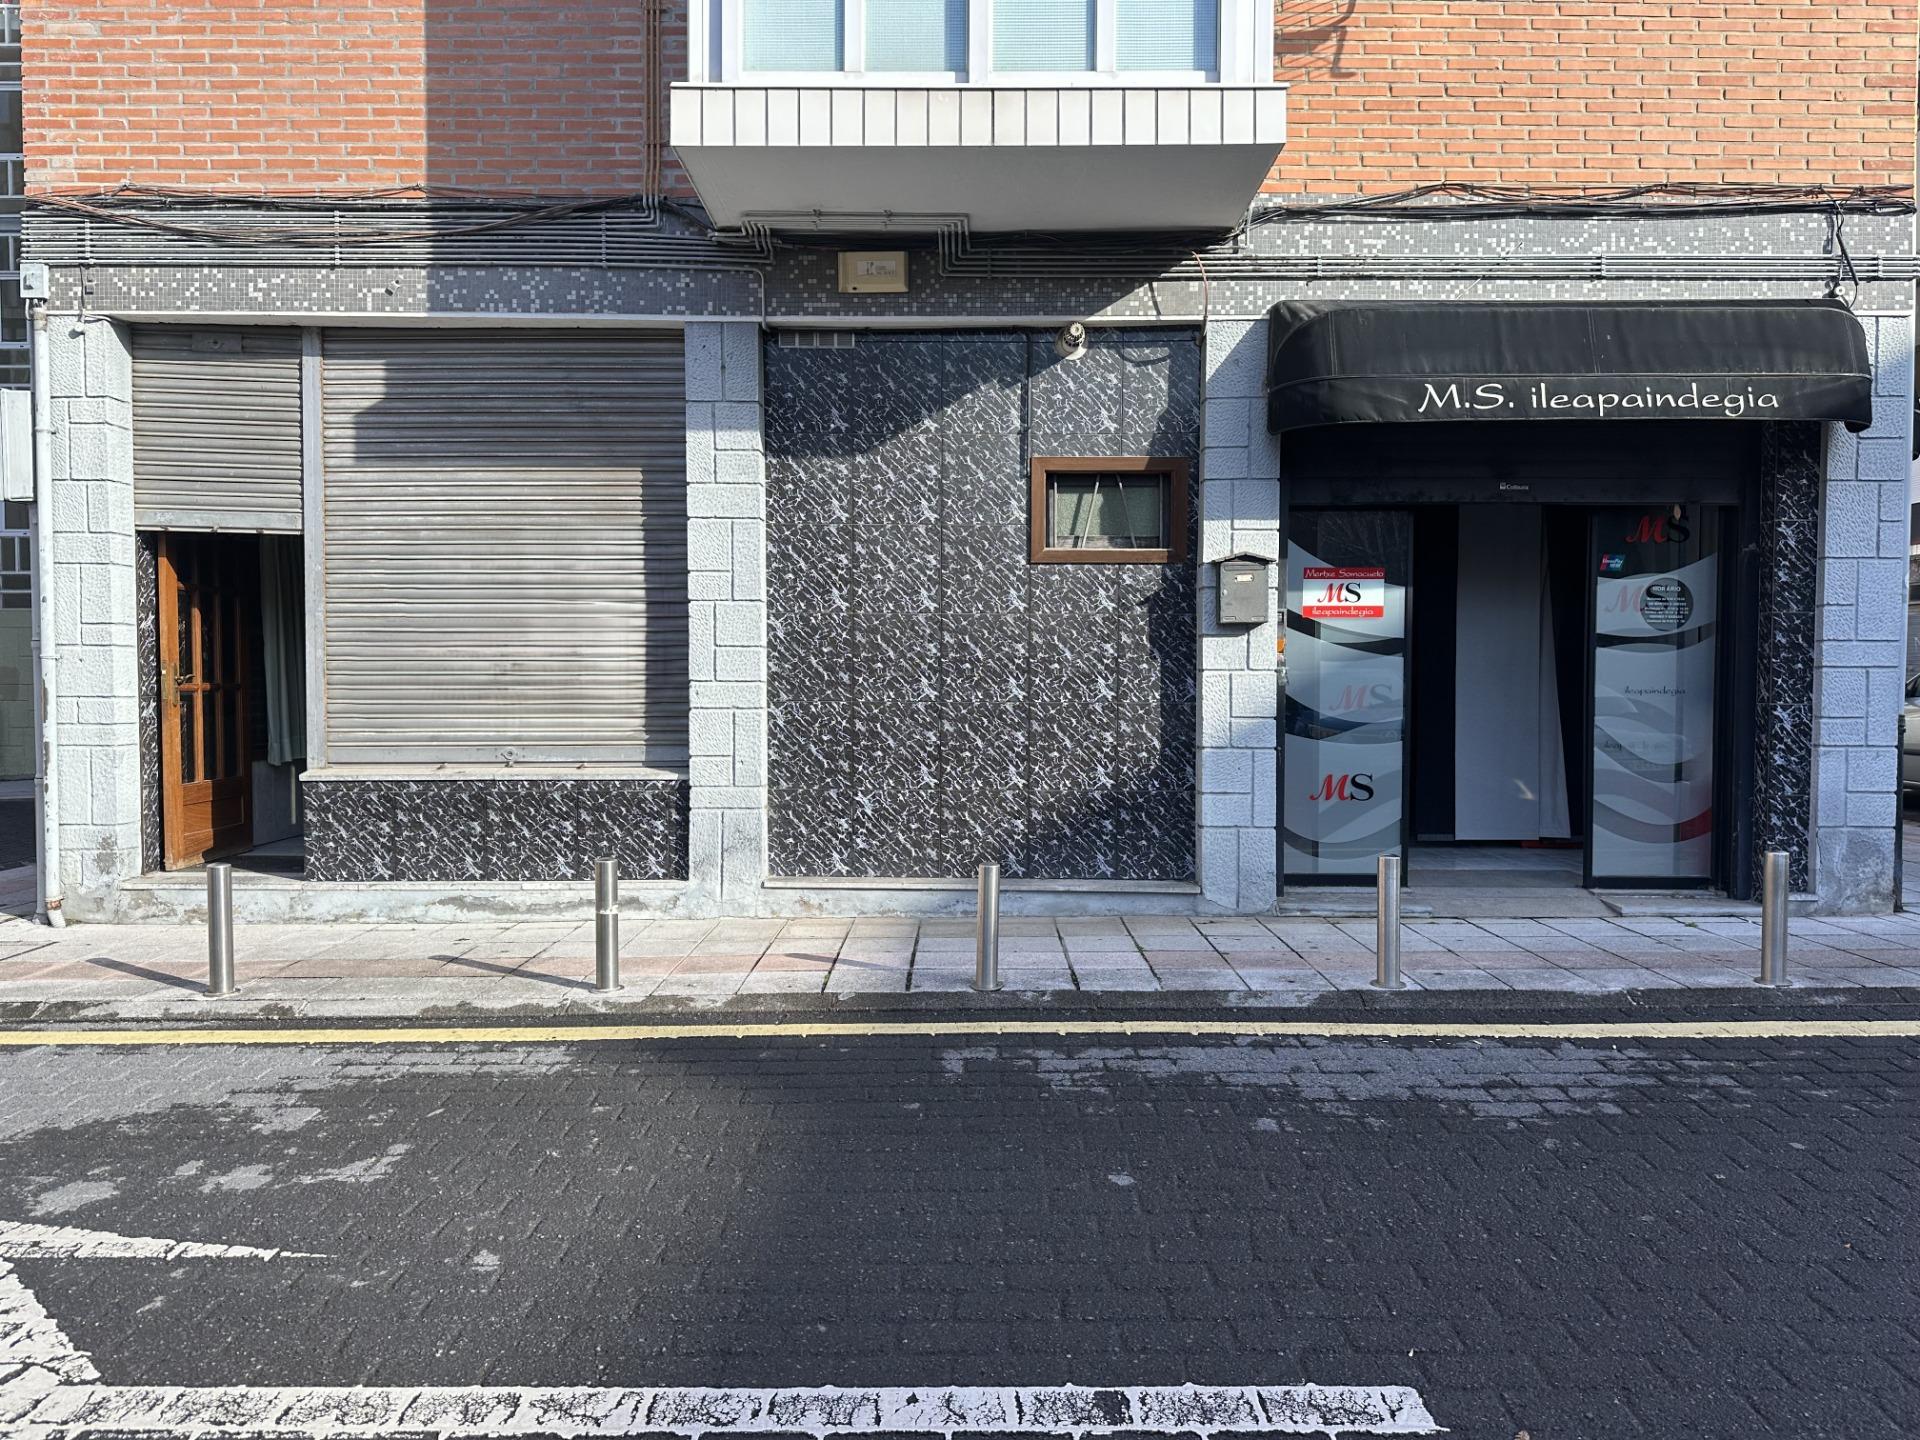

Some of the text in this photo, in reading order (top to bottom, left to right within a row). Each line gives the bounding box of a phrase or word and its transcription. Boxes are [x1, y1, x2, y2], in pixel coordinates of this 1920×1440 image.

[1417, 382, 1780, 417] M.S. ileapaindegia
[1624, 514, 1691, 543] MS
[1317, 582, 1361, 603] MS
[1311, 606, 1374, 617] ileapaindegia
[1328, 683, 1393, 711] MS
[1308, 772, 1375, 801] MS
